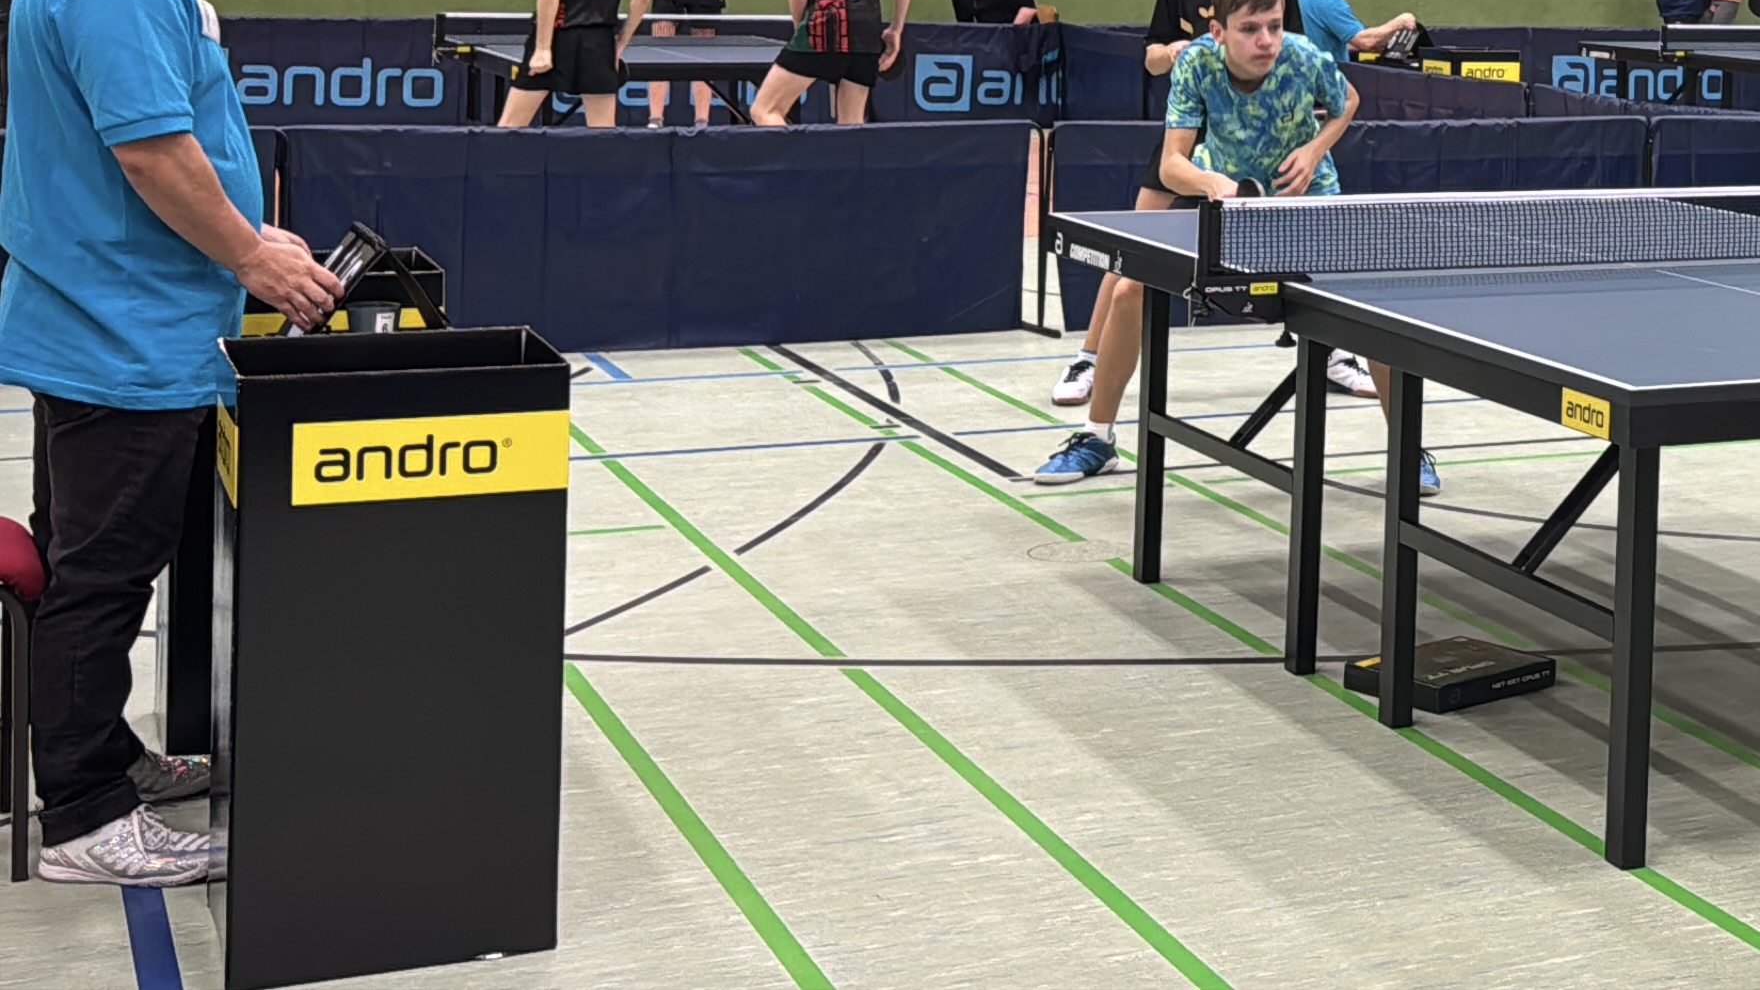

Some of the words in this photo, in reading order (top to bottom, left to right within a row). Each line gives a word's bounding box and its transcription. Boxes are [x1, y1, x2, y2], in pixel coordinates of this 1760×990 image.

[236, 57, 444, 107] andro
[1465, 66, 1505, 78] andro
[1565, 400, 1605, 429] andro
